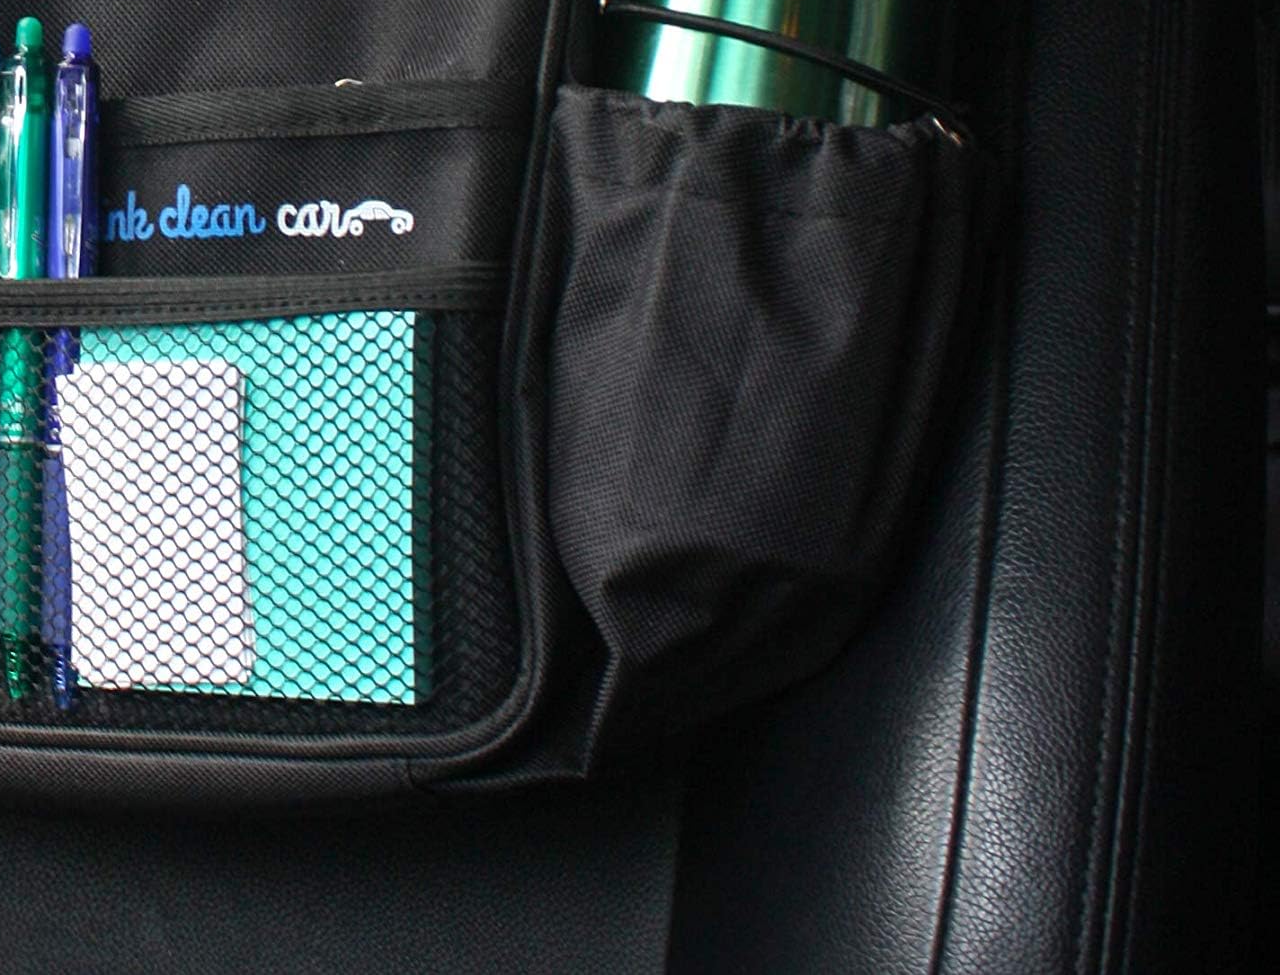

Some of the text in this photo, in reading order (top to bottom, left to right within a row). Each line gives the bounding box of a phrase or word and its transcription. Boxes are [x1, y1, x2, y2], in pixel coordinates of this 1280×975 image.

[105, 184, 349, 241] nk clean car
